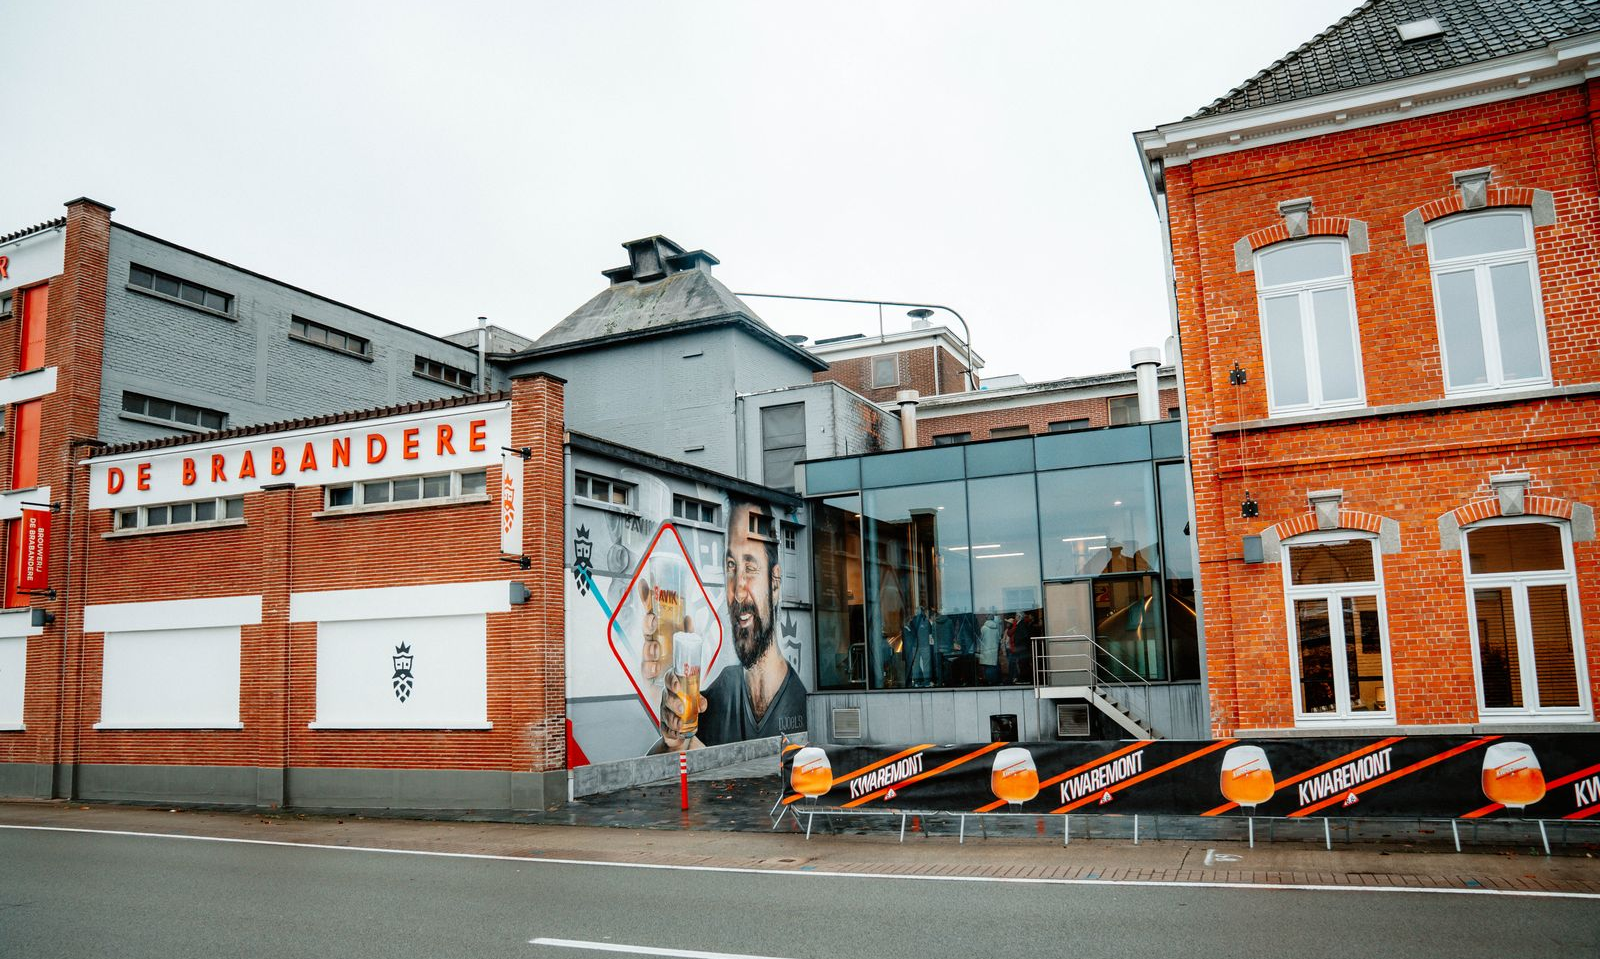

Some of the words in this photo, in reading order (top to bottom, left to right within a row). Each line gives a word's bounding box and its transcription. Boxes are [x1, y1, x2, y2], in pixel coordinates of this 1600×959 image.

[107, 463, 151, 495] DE
[182, 420, 487, 486] BRABANDERE
[30, 517, 37, 529] DE
[27, 530, 36, 581] BRABANDERE
[36, 527, 45, 573] BROUWERIJ
[849, 752, 923, 799] KWAREMONT
[1060, 750, 1144, 804] KWAREMONT
[1298, 748, 1392, 806] KWAREMONT
